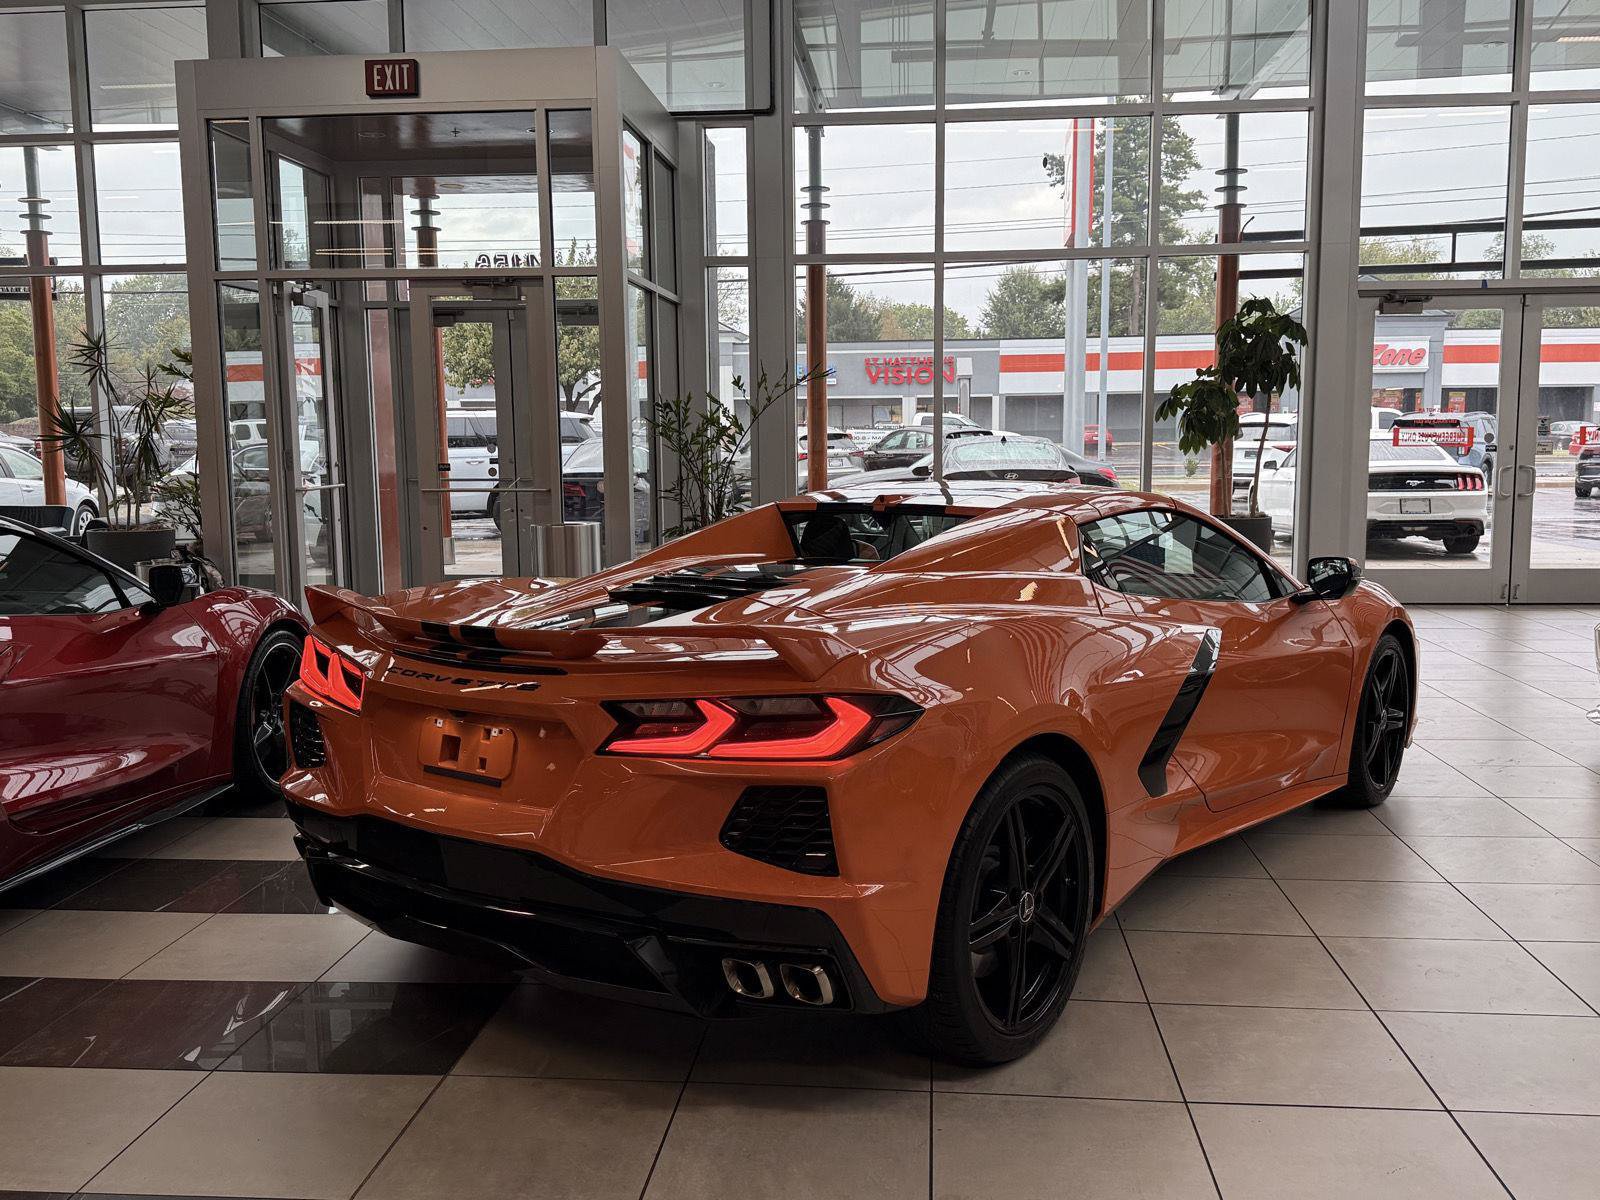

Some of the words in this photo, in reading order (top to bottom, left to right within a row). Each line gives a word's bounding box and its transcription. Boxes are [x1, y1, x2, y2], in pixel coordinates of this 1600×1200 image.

[373, 64, 410, 91] EXIT
[864, 367, 955, 385] VISION
[387, 667, 542, 692] CORVETTE
